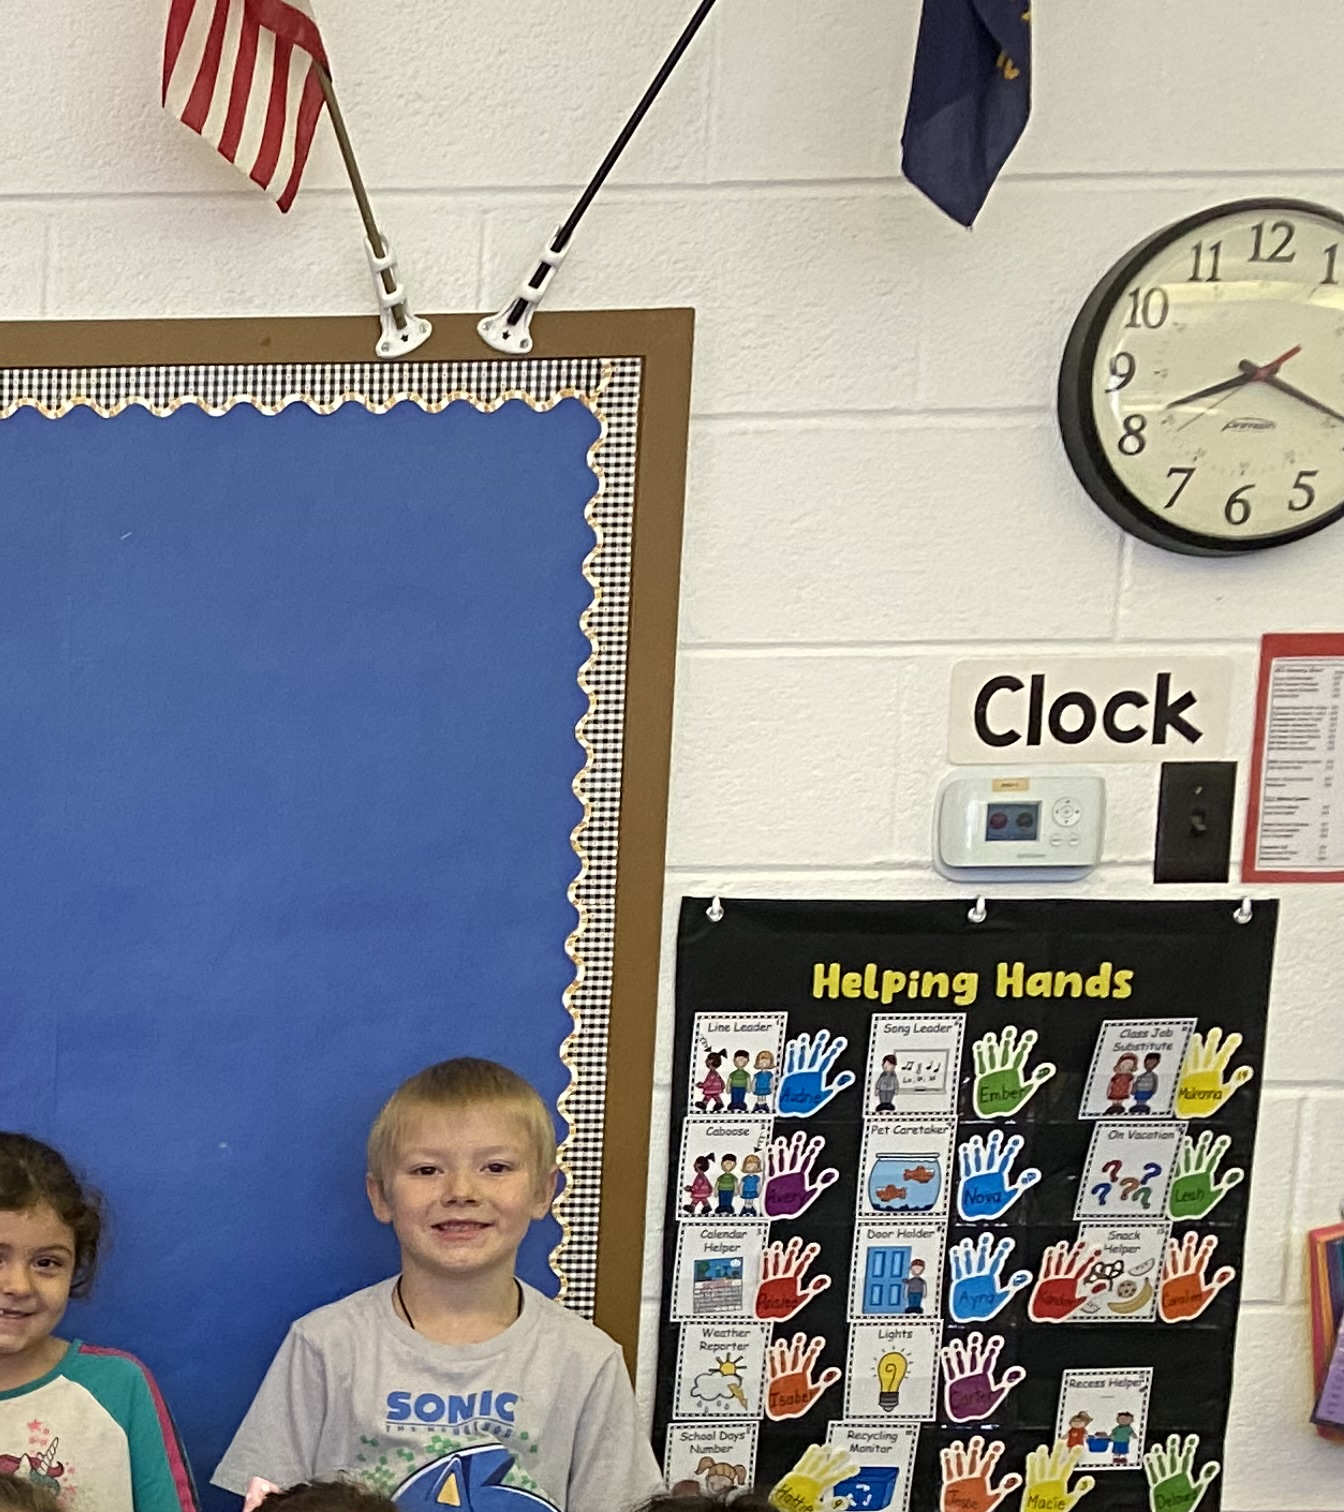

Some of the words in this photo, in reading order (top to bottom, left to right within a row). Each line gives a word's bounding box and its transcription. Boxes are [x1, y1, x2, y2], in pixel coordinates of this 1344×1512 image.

[1248, 220, 1296, 262] 12
[1188, 241, 1222, 282] 11
[1320, 244, 1340, 284] 1
[1126, 287, 1168, 328] 10
[1105, 352, 1136, 394] 9
[1118, 414, 1147, 456] 8
[1163, 467, 1196, 509] 7
[1288, 470, 1318, 511] 5
[1224, 484, 1256, 526] 6
[974, 672, 1204, 747] Clock
[813, 962, 978, 1006] Helping
[995, 962, 1134, 998] Hands
[708, 1021, 730, 1032] Line
[734, 1020, 772, 1032] Leader
[884, 1024, 910, 1036] Song
[914, 1023, 952, 1034] Leader
[1120, 1028, 1148, 1038] Class
[1150, 1028, 1174, 1038] Job
[1113, 1042, 1172, 1052] Substitute
[980, 1086, 1026, 1103] Ember
[706, 1127, 750, 1136] Caboose
[871, 1126, 890, 1135] Pet
[892, 1125, 949, 1135] Caretaker
[1108, 1130, 1124, 1140] On
[1128, 1130, 1174, 1140] Vacation
[964, 1187, 1002, 1206] Nova
[700, 1229, 748, 1239] Calendar
[867, 1230, 894, 1239] Door
[897, 1228, 934, 1239] Holder
[1108, 1230, 1140, 1240] Snack
[704, 1243, 740, 1254] Helper
[1104, 1244, 1140, 1256] Helper
[702, 1328, 750, 1338] Weather
[878, 1330, 912, 1341] Lights
[700, 1341, 749, 1352] Reporter
[1069, 1379, 1106, 1388] Recess
[1108, 1378, 1144, 1389] Helper
[386, 1390, 518, 1424] SONIC
[680, 1431, 716, 1441] School
[720, 1430, 745, 1442] Days
[848, 1430, 898, 1442] Recycling
[690, 1444, 733, 1454] Number
[850, 1444, 892, 1453] Monitor
[1027, 1494, 1066, 1511] Macie
